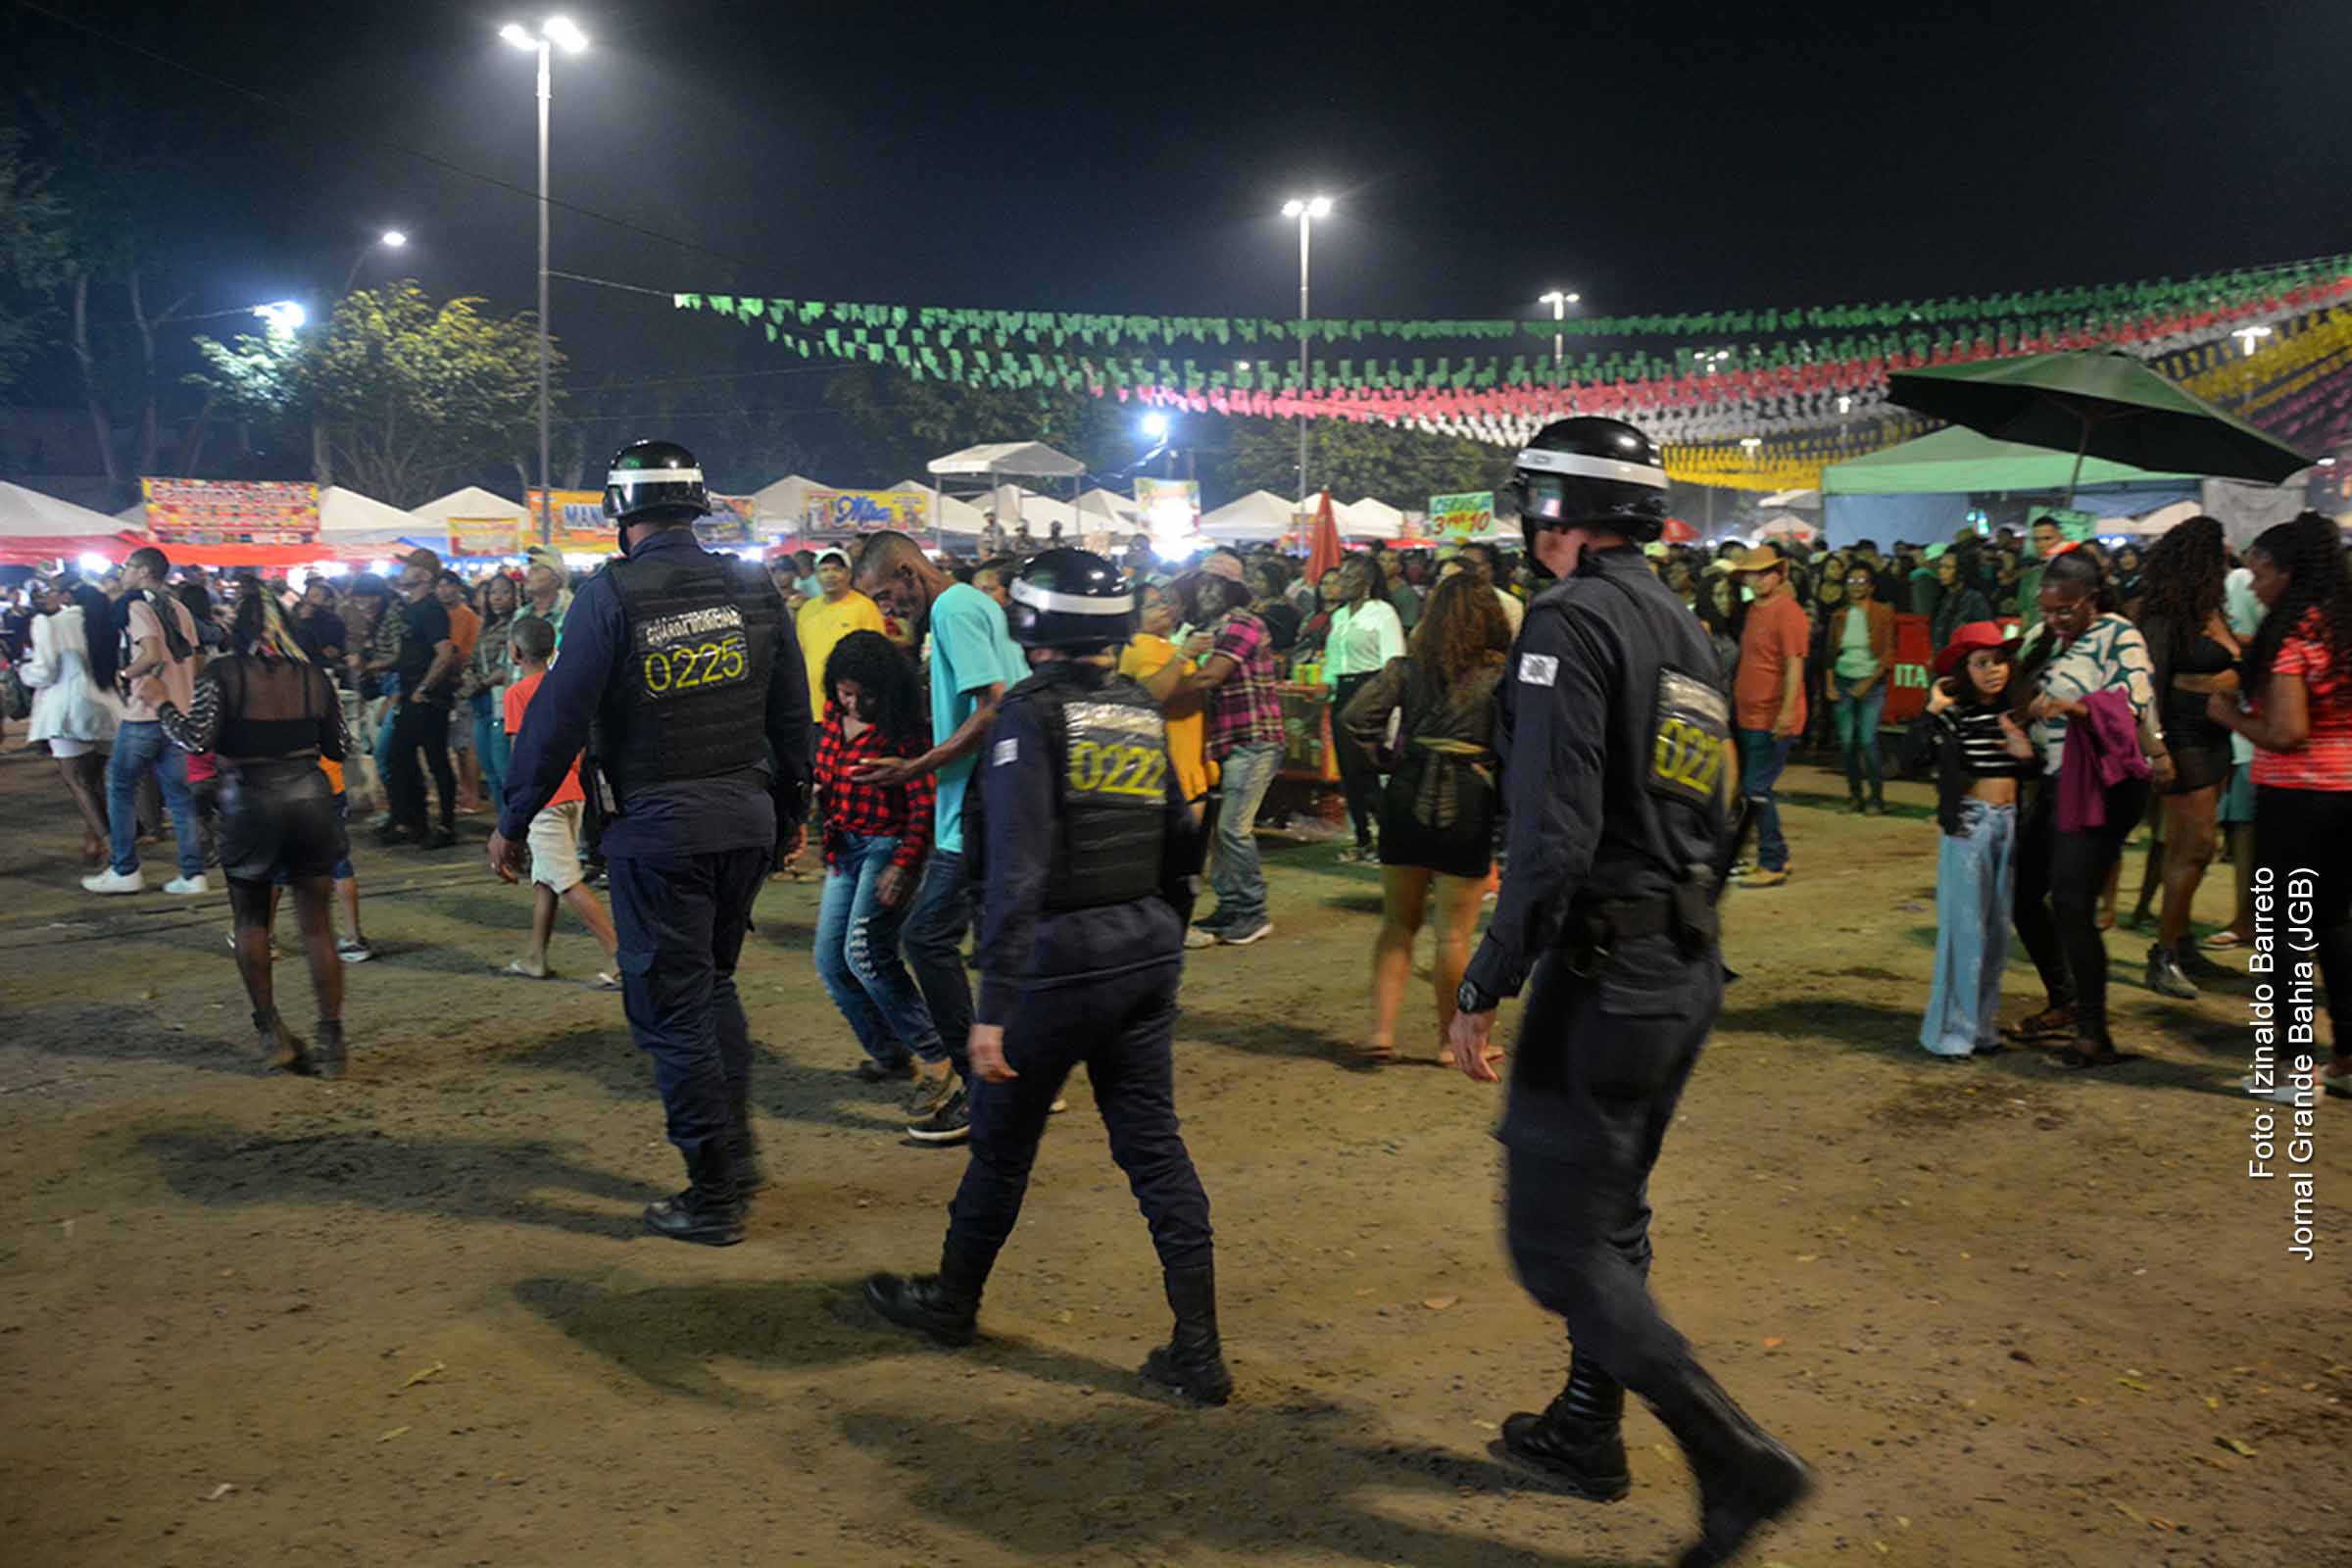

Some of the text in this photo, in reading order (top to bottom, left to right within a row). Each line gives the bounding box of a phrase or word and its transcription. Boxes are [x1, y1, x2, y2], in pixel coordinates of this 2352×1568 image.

[1433, 516, 1445, 535] 3
[1466, 511, 1491, 533] 10
[645, 636, 743, 691] 0225
